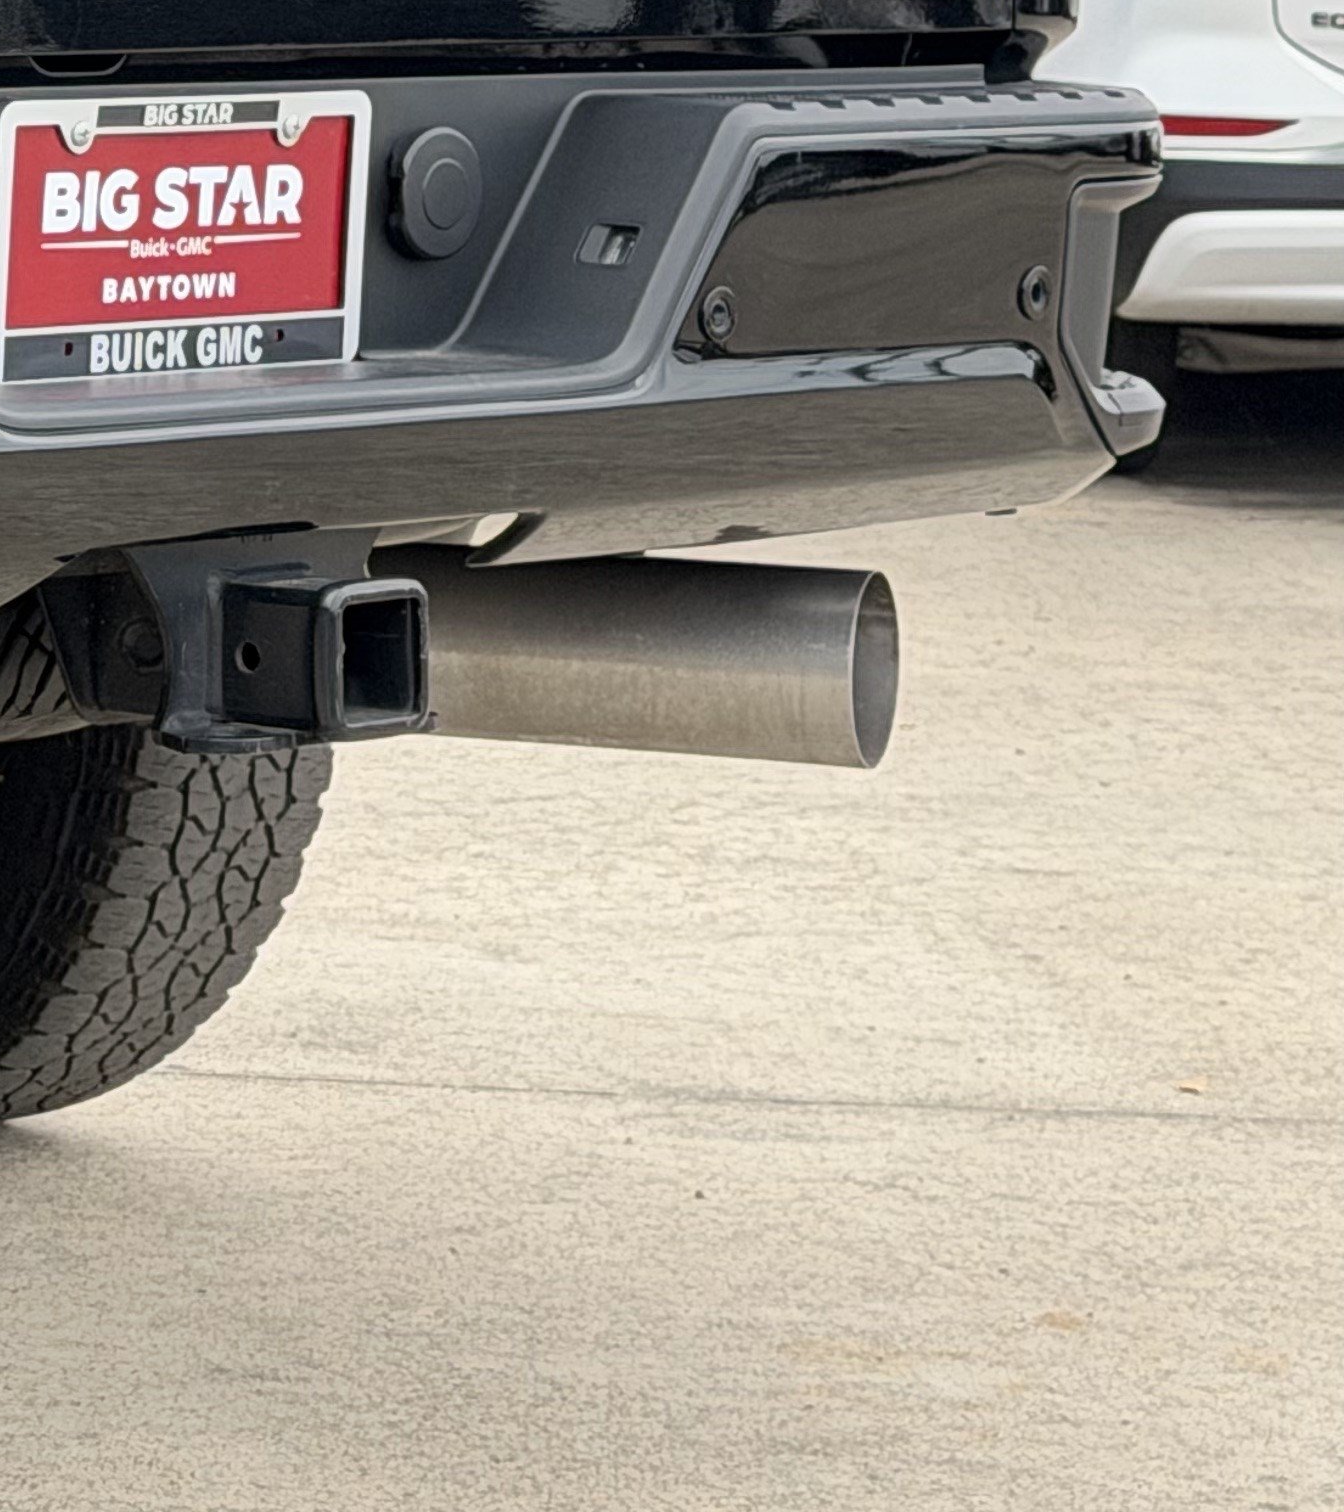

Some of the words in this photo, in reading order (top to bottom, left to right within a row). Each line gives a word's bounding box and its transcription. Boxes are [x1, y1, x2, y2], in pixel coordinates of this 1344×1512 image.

[143, 103, 178, 126] BIG
[181, 101, 234, 126] STAR
[41, 168, 141, 235] BIG
[152, 163, 304, 230] STAR
[102, 272, 236, 304] BAYTOWN
[89, 328, 188, 374] BUICK
[196, 323, 265, 367] GMC
